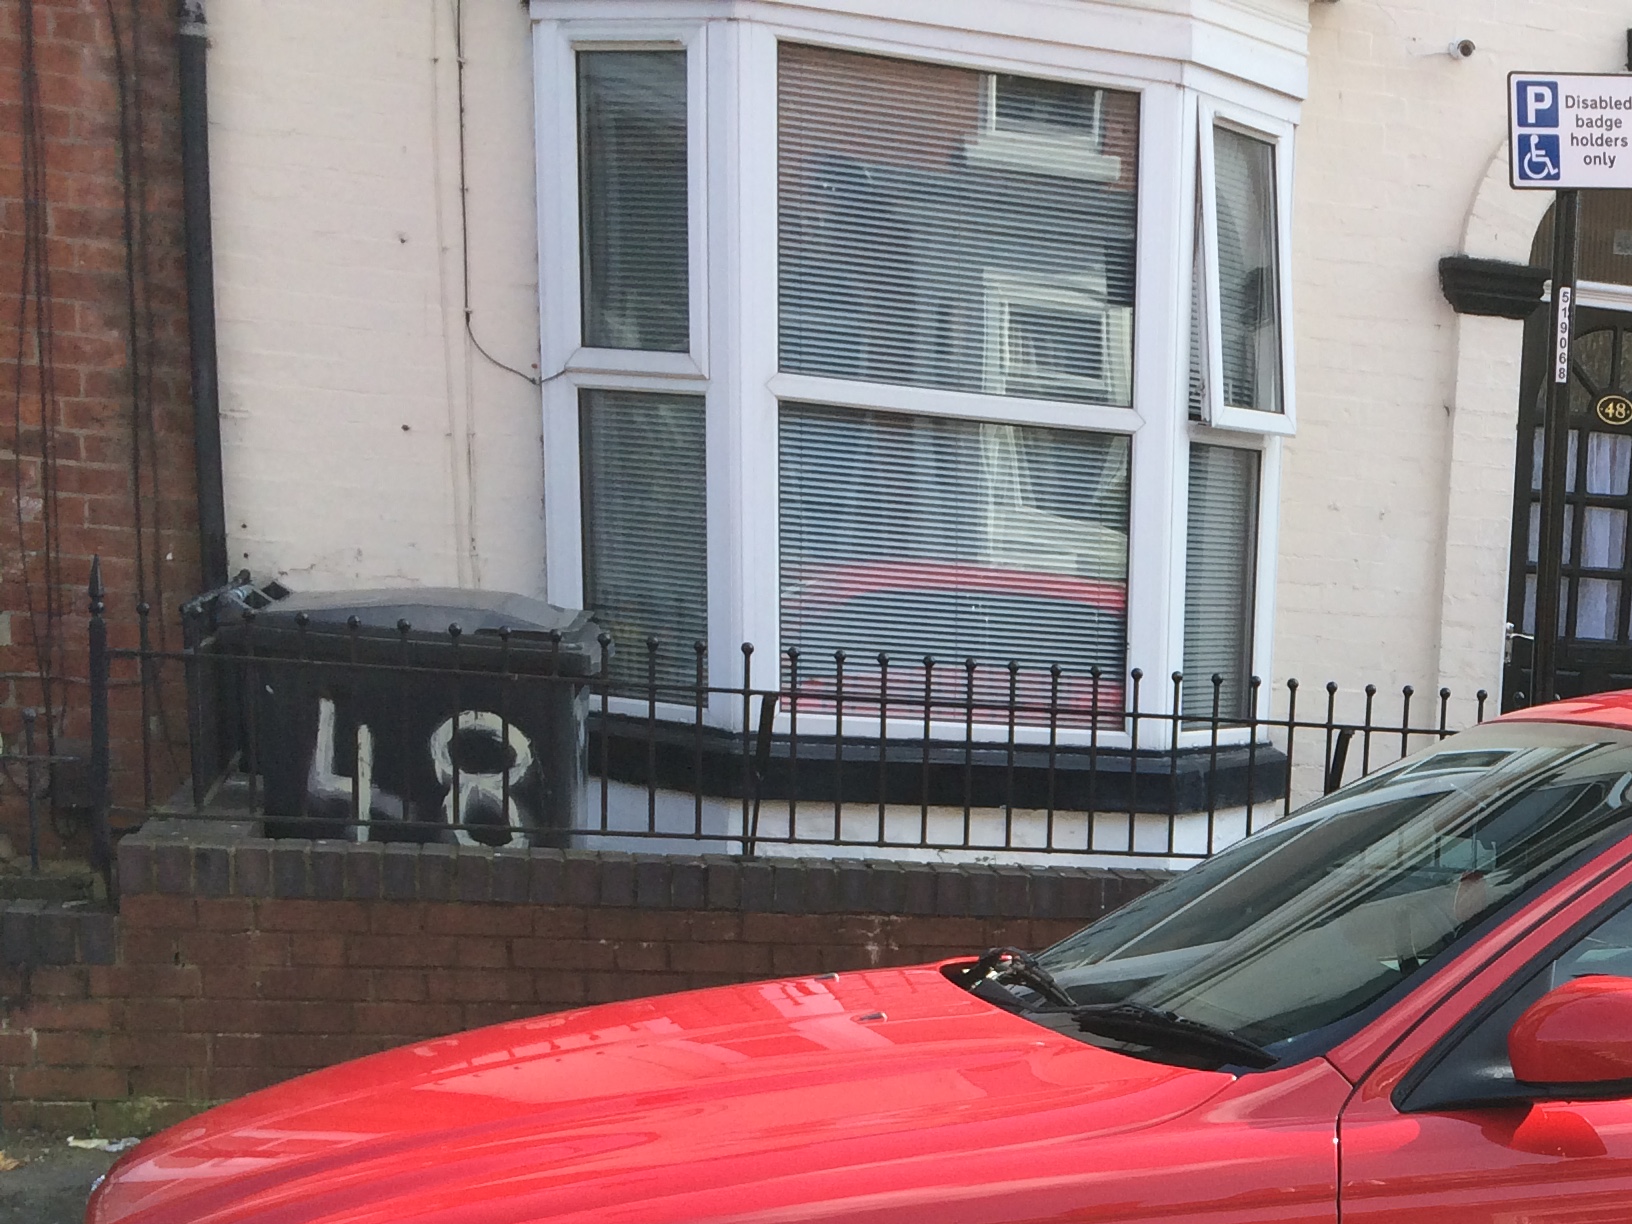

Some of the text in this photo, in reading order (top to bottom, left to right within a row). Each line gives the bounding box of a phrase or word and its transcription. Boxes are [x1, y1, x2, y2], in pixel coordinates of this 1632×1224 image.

[1527, 85, 1553, 124] P
[1565, 95, 1632, 110] Disabled
[1575, 114, 1623, 131] badge
[1570, 133, 1629, 147] holders
[1583, 152, 1616, 168] only
[1604, 402, 1626, 419] 48
[307, 697, 533, 848] 48
